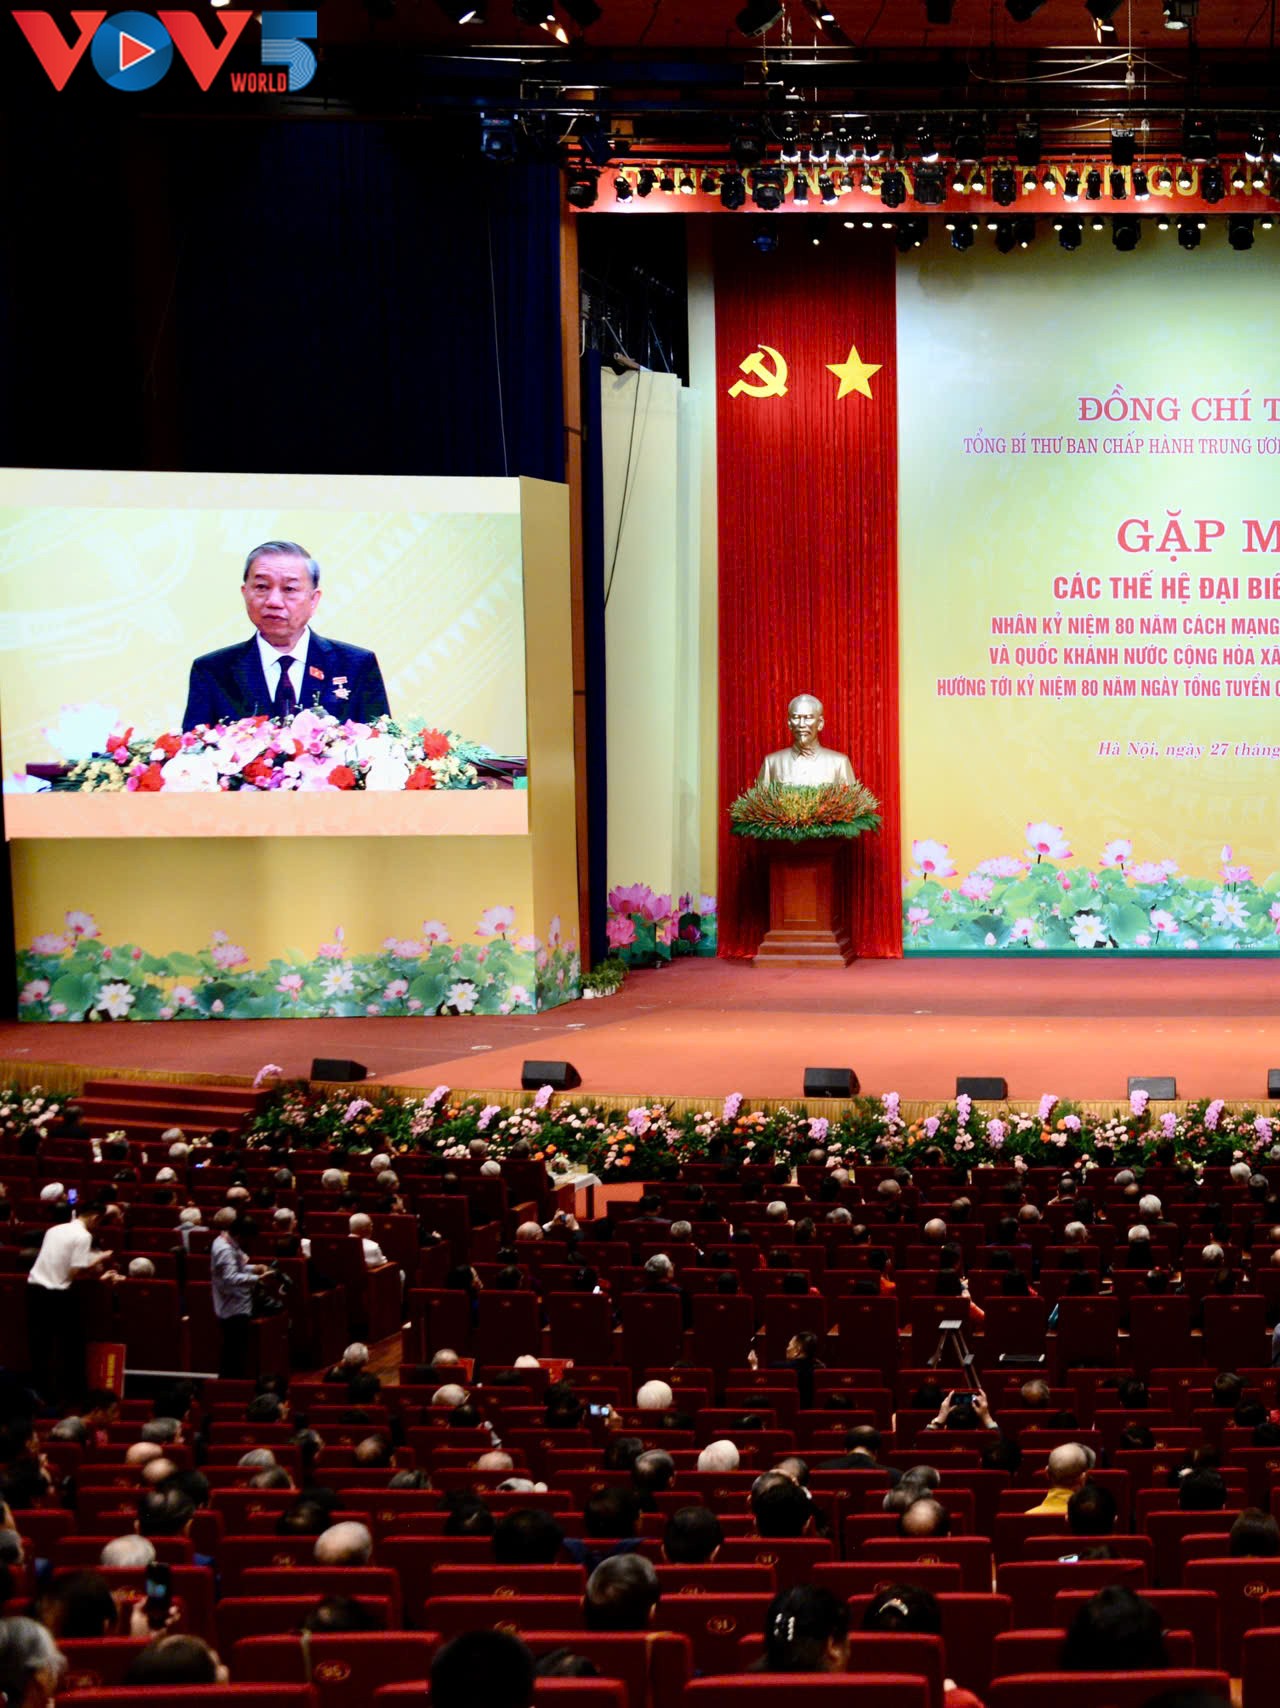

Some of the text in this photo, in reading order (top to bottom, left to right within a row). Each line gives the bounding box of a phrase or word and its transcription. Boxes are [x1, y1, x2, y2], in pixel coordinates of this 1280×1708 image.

[1078, 383, 1180, 422] ĐỒNG
[1191, 389, 1251, 422] CHÍ
[963, 428, 1006, 454] TỔNG
[1011, 432, 1027, 454] BÍ
[1031, 436, 1063, 454] THƯ
[1066, 438, 1098, 454] BAN
[1102, 430, 1144, 454] CHẤP
[1149, 433, 1194, 454] HÀNH
[1198, 438, 1252, 455] TRUNG
[1117, 508, 1226, 563] GẶP
[1053, 572, 1102, 600] CÁC
[1109, 569, 1153, 600] THẾ
[1161, 572, 1191, 606] HỆ
[1199, 576, 1240, 606] ĐẠI
[991, 614, 1038, 635] NHÂN
[1042, 611, 1063, 635] KỶ
[1067, 614, 1110, 638] NIỆM
[1115, 617, 1135, 635] 80
[1139, 614, 1178, 635] NĂM
[1182, 614, 1226, 635] CÁCH
[1231, 617, 1280, 638] MẠNG
[988, 644, 1011, 665] VÀ
[1014, 641, 1058, 665] QUỐC
[1063, 644, 1119, 665] KHÁNH
[1123, 641, 1168, 665] NƯỚC
[1173, 644, 1218, 669] CỘNG
[1222, 644, 1256, 665] HÒA
[937, 673, 987, 697] HƯỚNG
[990, 673, 1013, 697] TỚI
[1016, 673, 1035, 697] KỶ
[1039, 676, 1077, 701] NIỆM
[1080, 679, 1099, 697] 80
[1102, 676, 1137, 697] NĂM
[1140, 676, 1179, 697] NGÀY
[1183, 673, 1222, 697] TỔNG
[1225, 673, 1271, 697] TUYỂN
[1099, 742, 1120, 756] Hà
[1127, 742, 1159, 759] Nội,
[1165, 742, 1205, 759] ngày
[1210, 743, 1230, 756] 27
[1234, 742, 1280, 758] tháng
